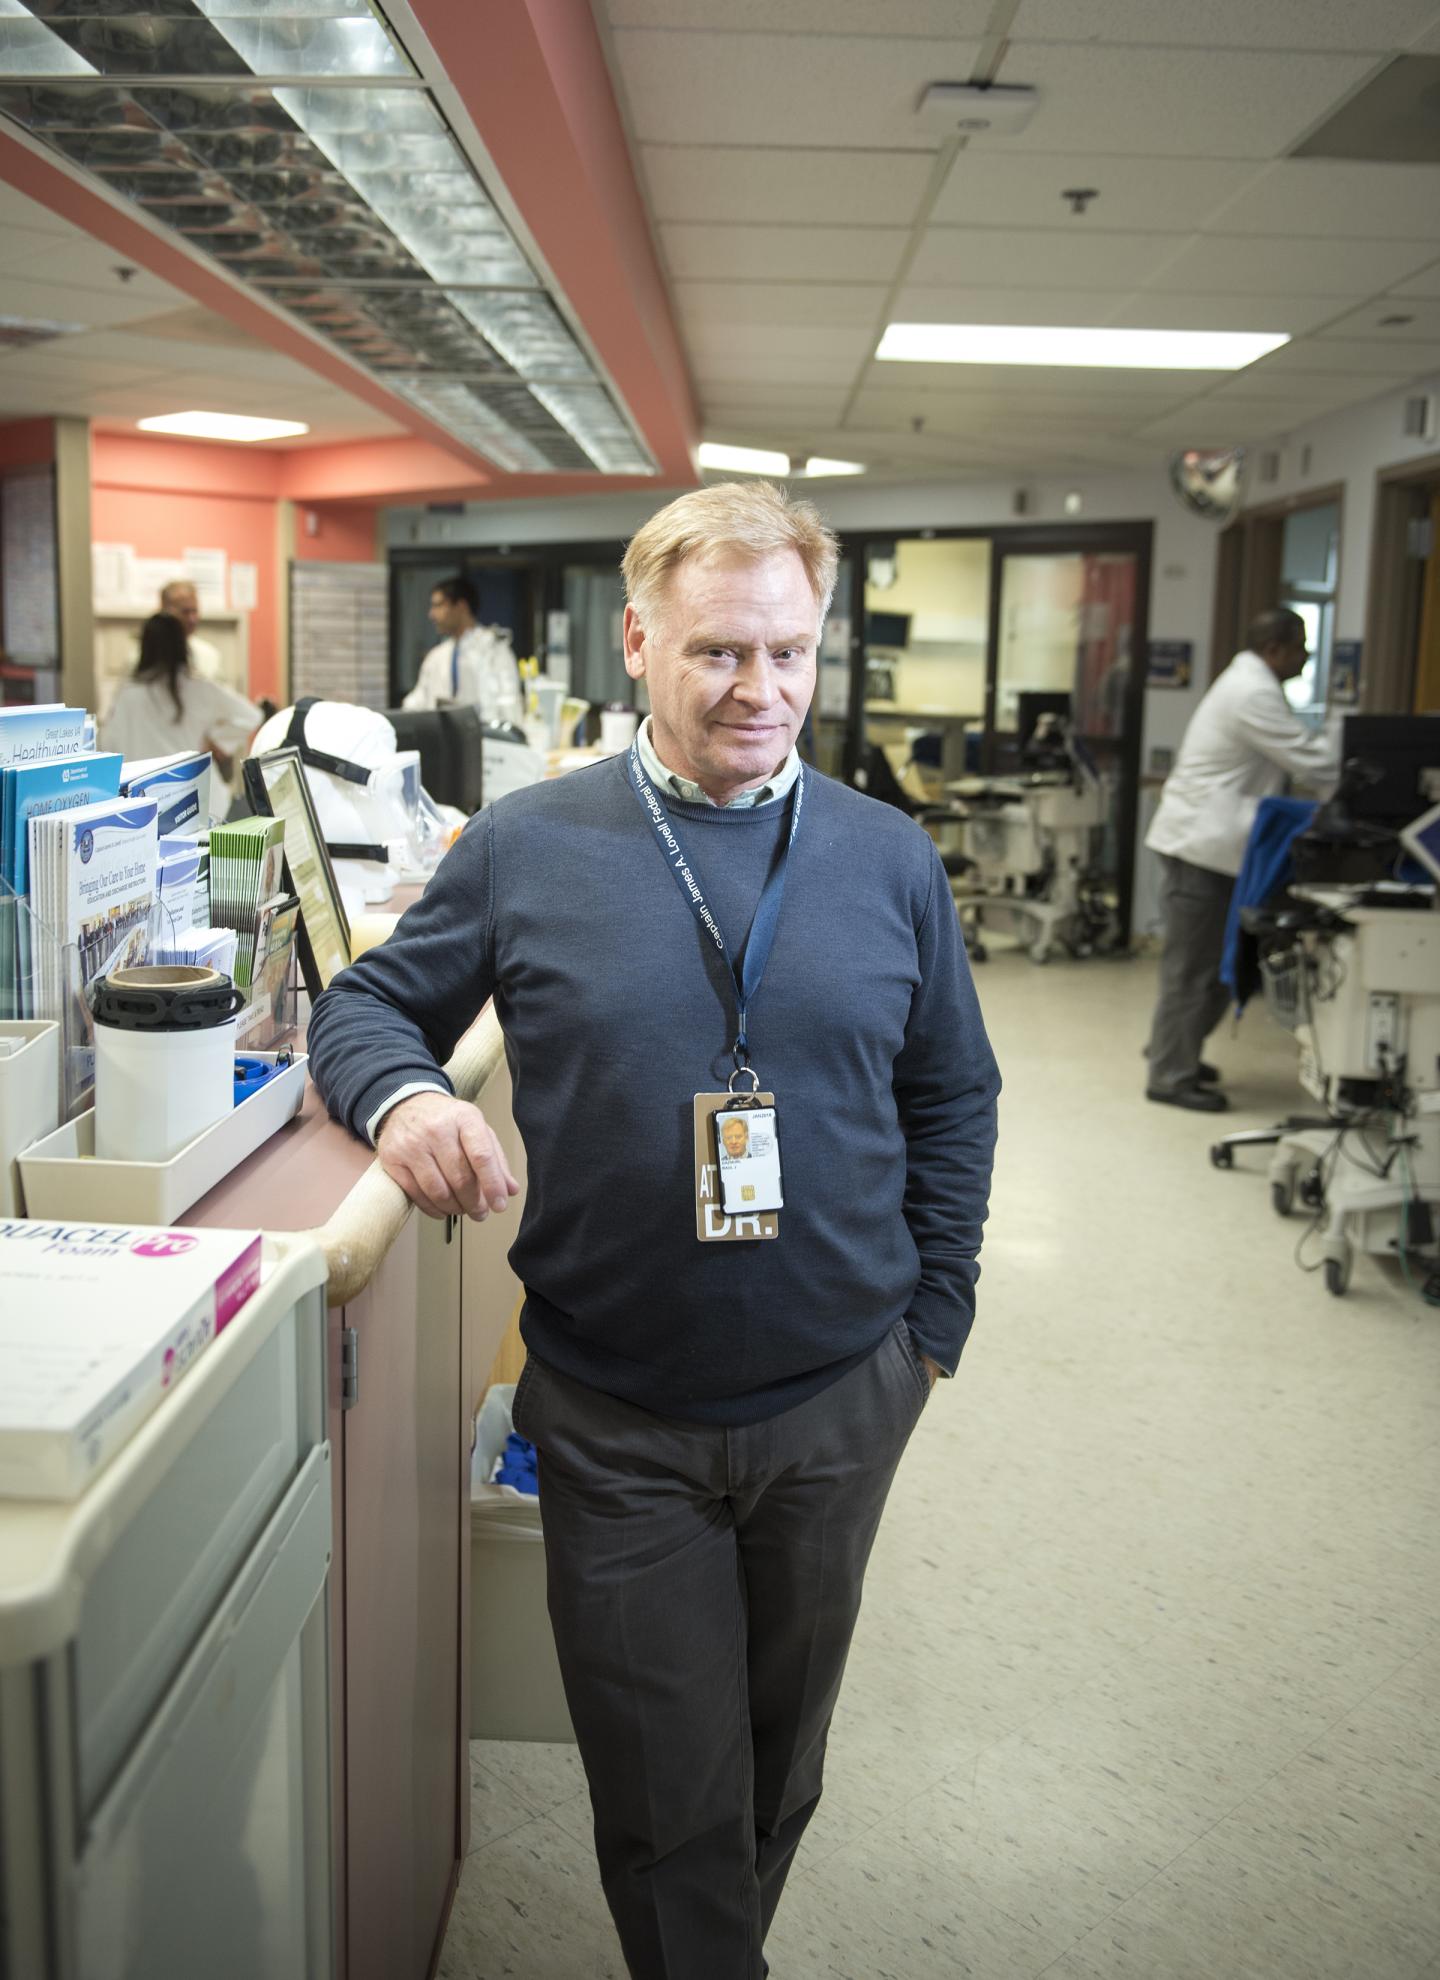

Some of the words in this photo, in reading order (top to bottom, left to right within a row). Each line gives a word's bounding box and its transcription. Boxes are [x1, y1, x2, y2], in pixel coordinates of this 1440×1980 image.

[631, 757, 647, 788] Health
[640, 785, 665, 824] Federal
[658, 823, 680, 856] Lovell
[675, 855, 687, 868] A.
[682, 867, 704, 903] James
[700, 905, 724, 950] Captain
[704, 1203, 773, 1238] DR.
